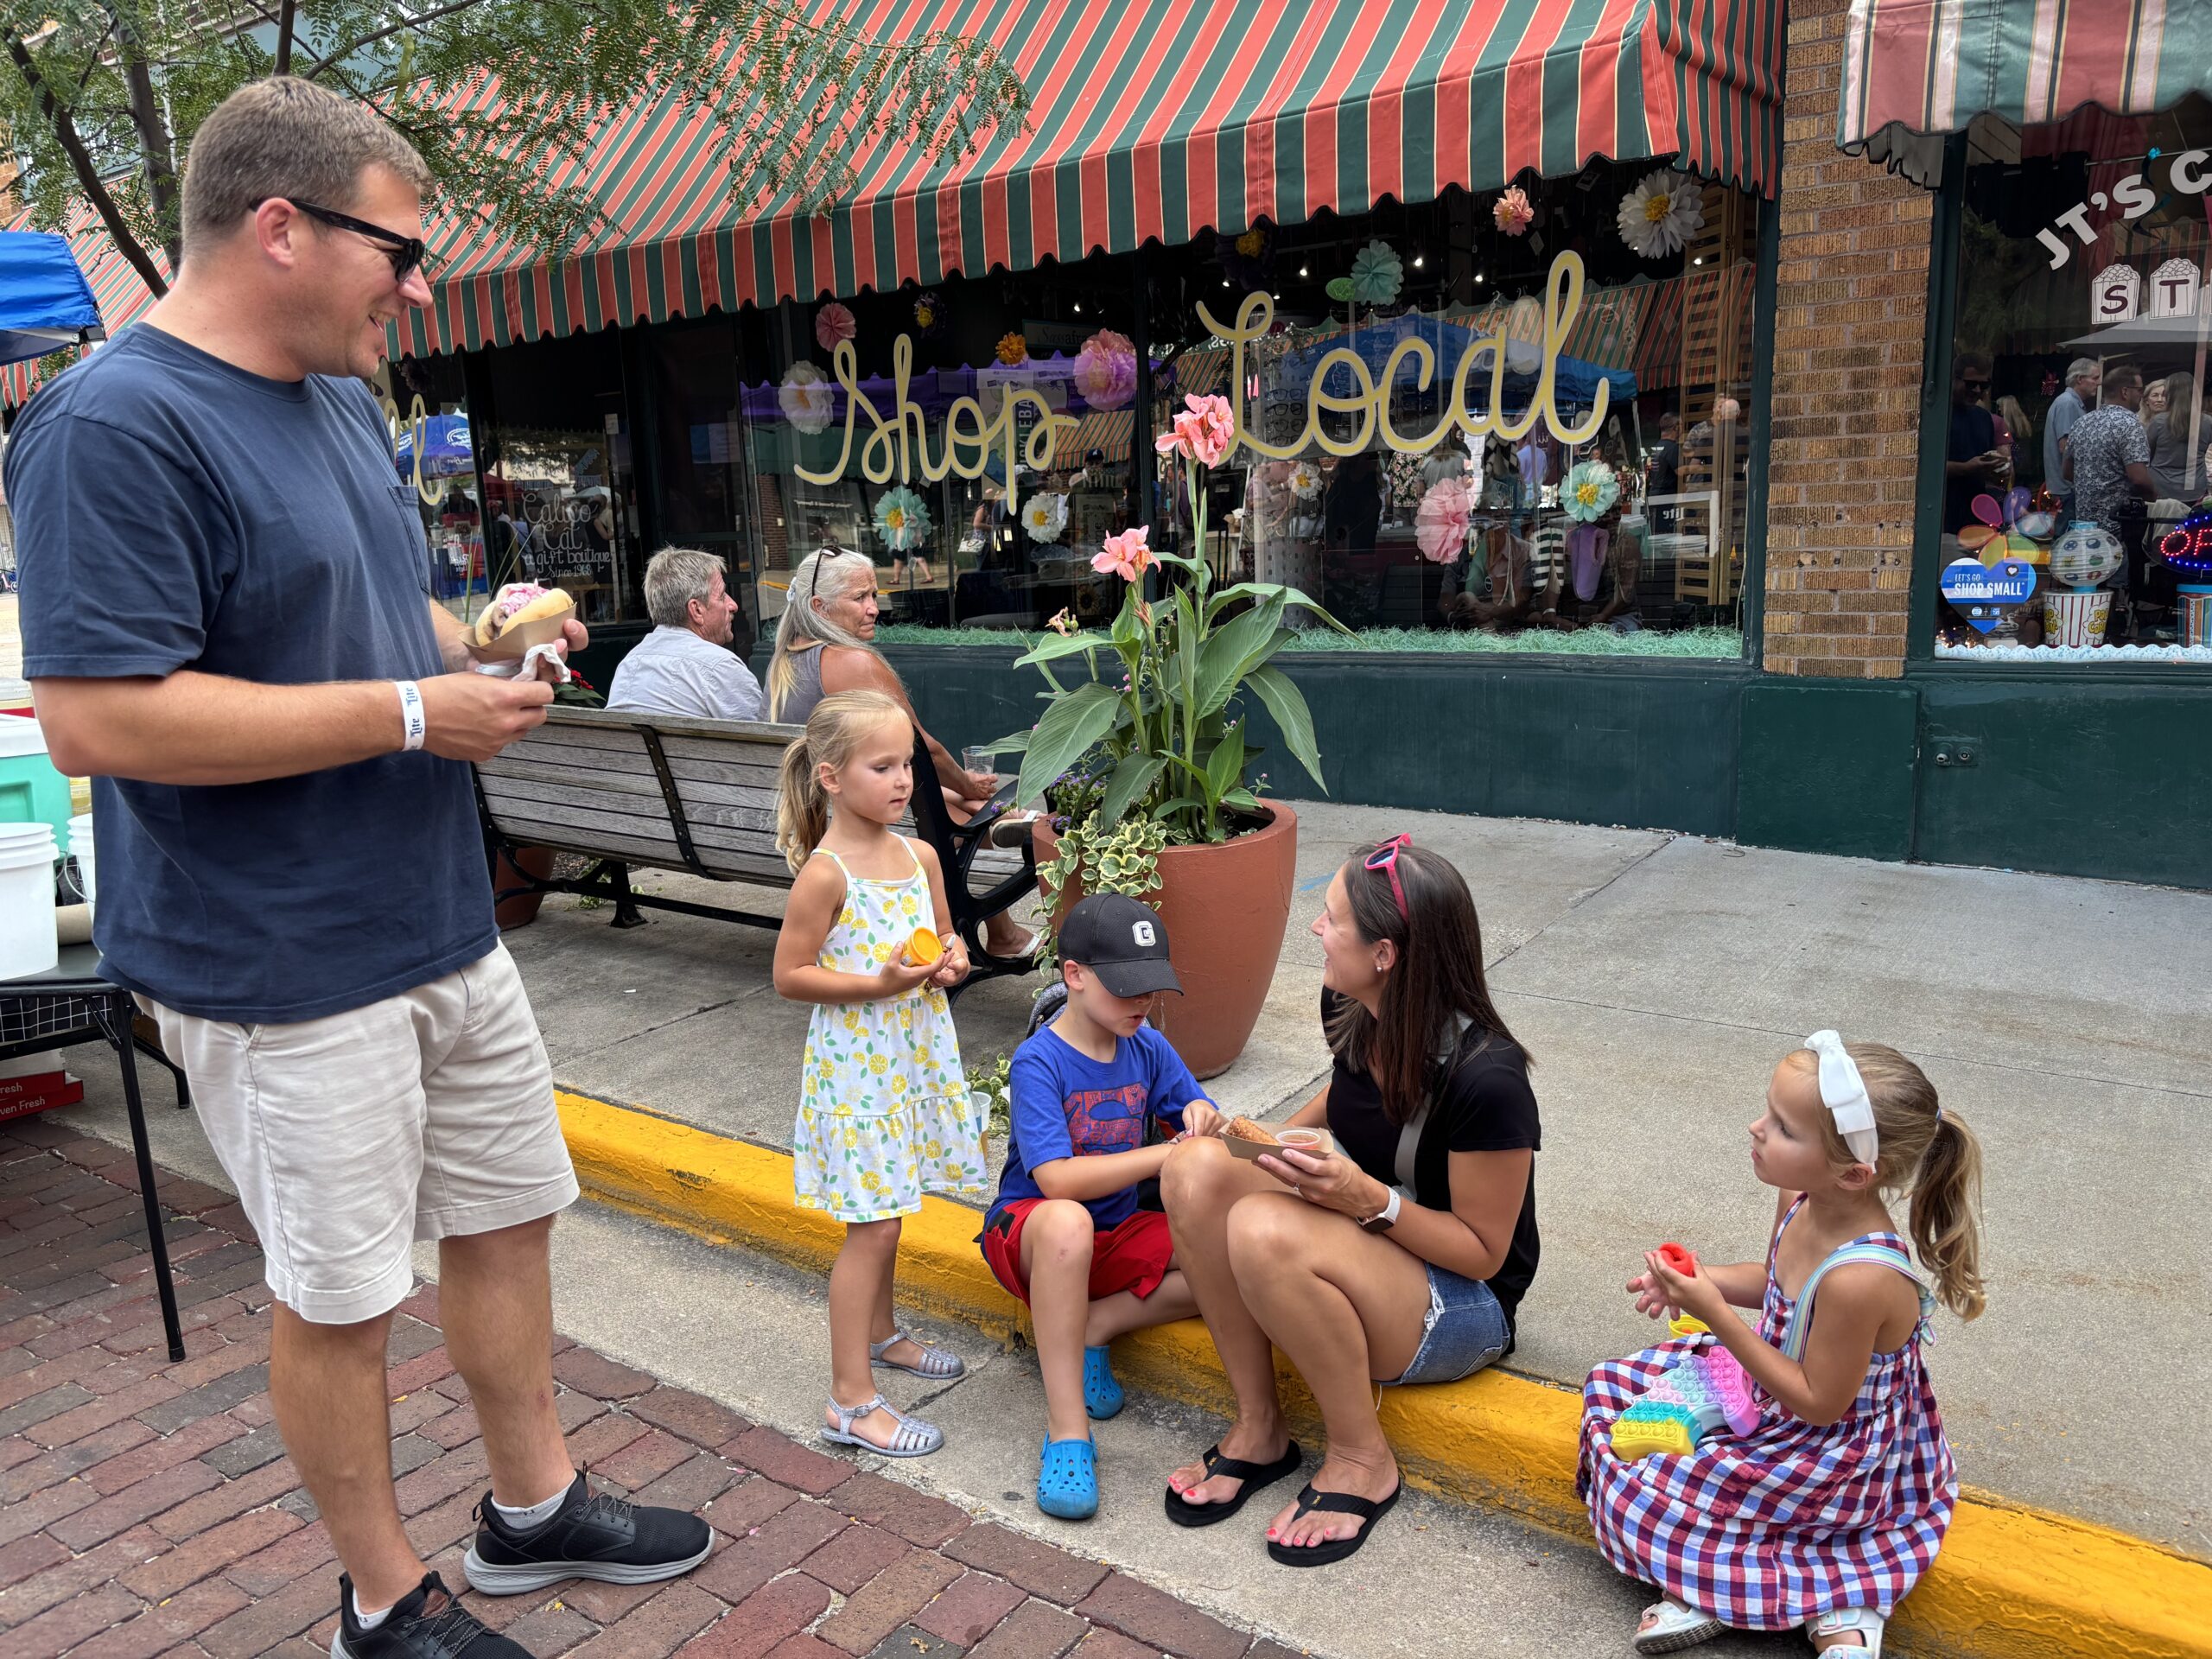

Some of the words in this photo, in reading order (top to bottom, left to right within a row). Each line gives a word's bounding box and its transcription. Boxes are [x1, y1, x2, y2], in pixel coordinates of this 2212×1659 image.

[793, 334, 1080, 516] Shop
[1196, 250, 1610, 467] Local
[521, 493, 599, 524] Calico
[543, 522, 583, 550] Cat
[537, 550, 564, 574] gift
[567, 548, 611, 573] boutique
[546, 565, 574, 578] Since
[573, 563, 594, 577] 1968
[1955, 573, 1971, 582] LET'S
[1972, 573, 1980, 582] GO
[1954, 582, 1984, 596] SHOP
[19, 1096, 46, 1110] Fresh
